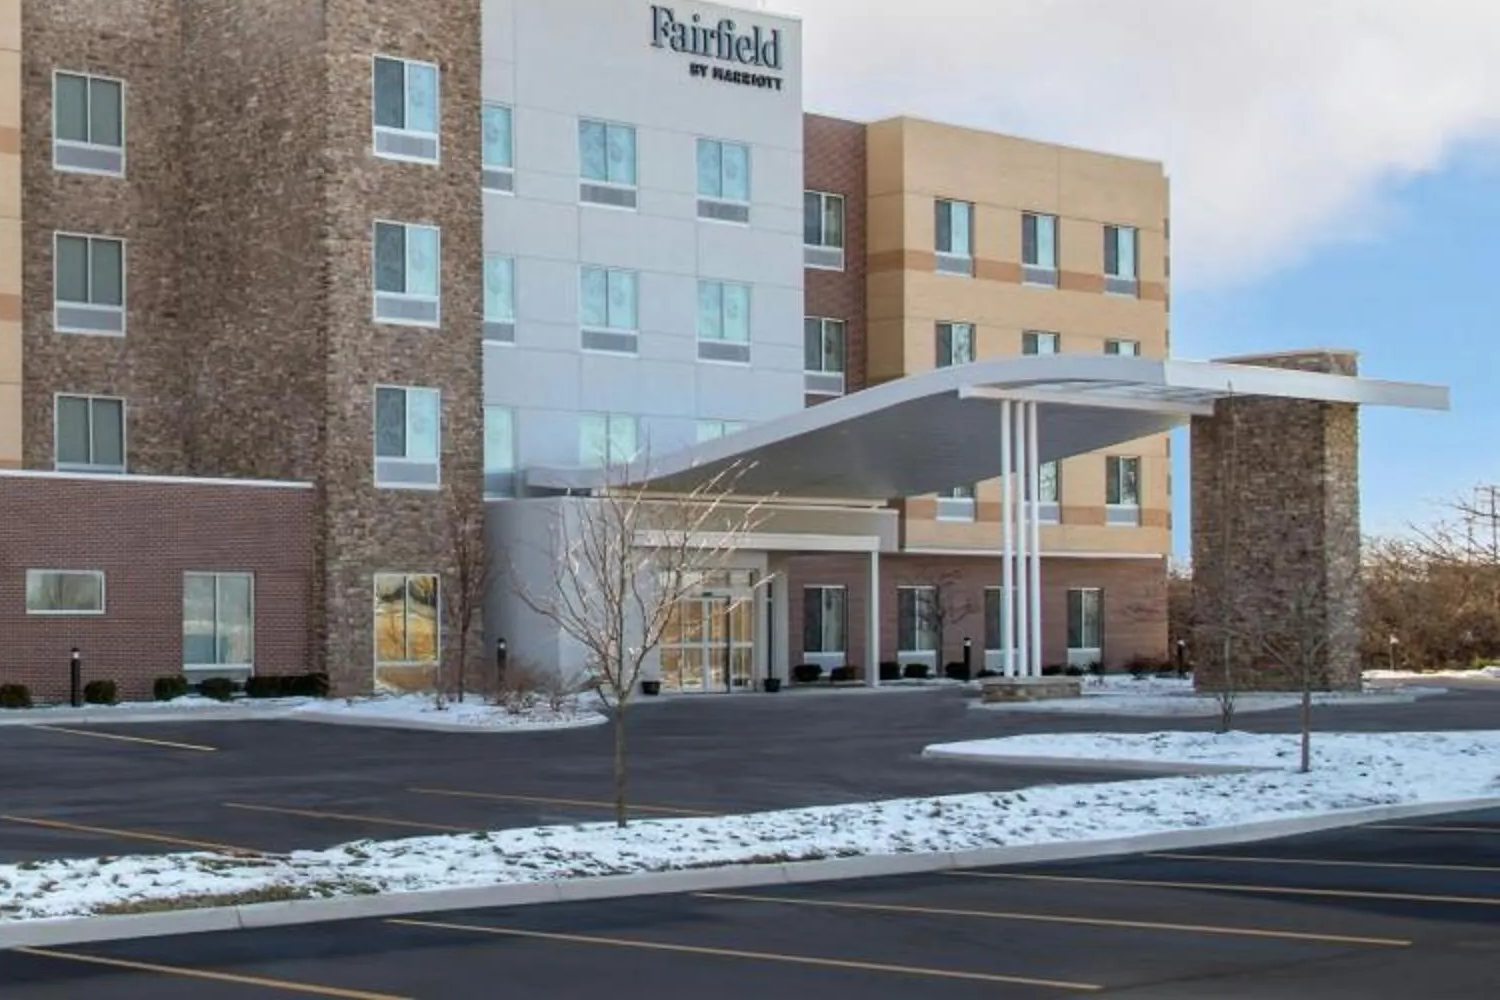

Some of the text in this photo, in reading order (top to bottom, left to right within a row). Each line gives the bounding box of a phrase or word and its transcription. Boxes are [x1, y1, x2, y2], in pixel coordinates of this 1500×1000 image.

[650, 5, 782, 70] Fairfield
[689, 62, 783, 91] BY MARRIOTT
